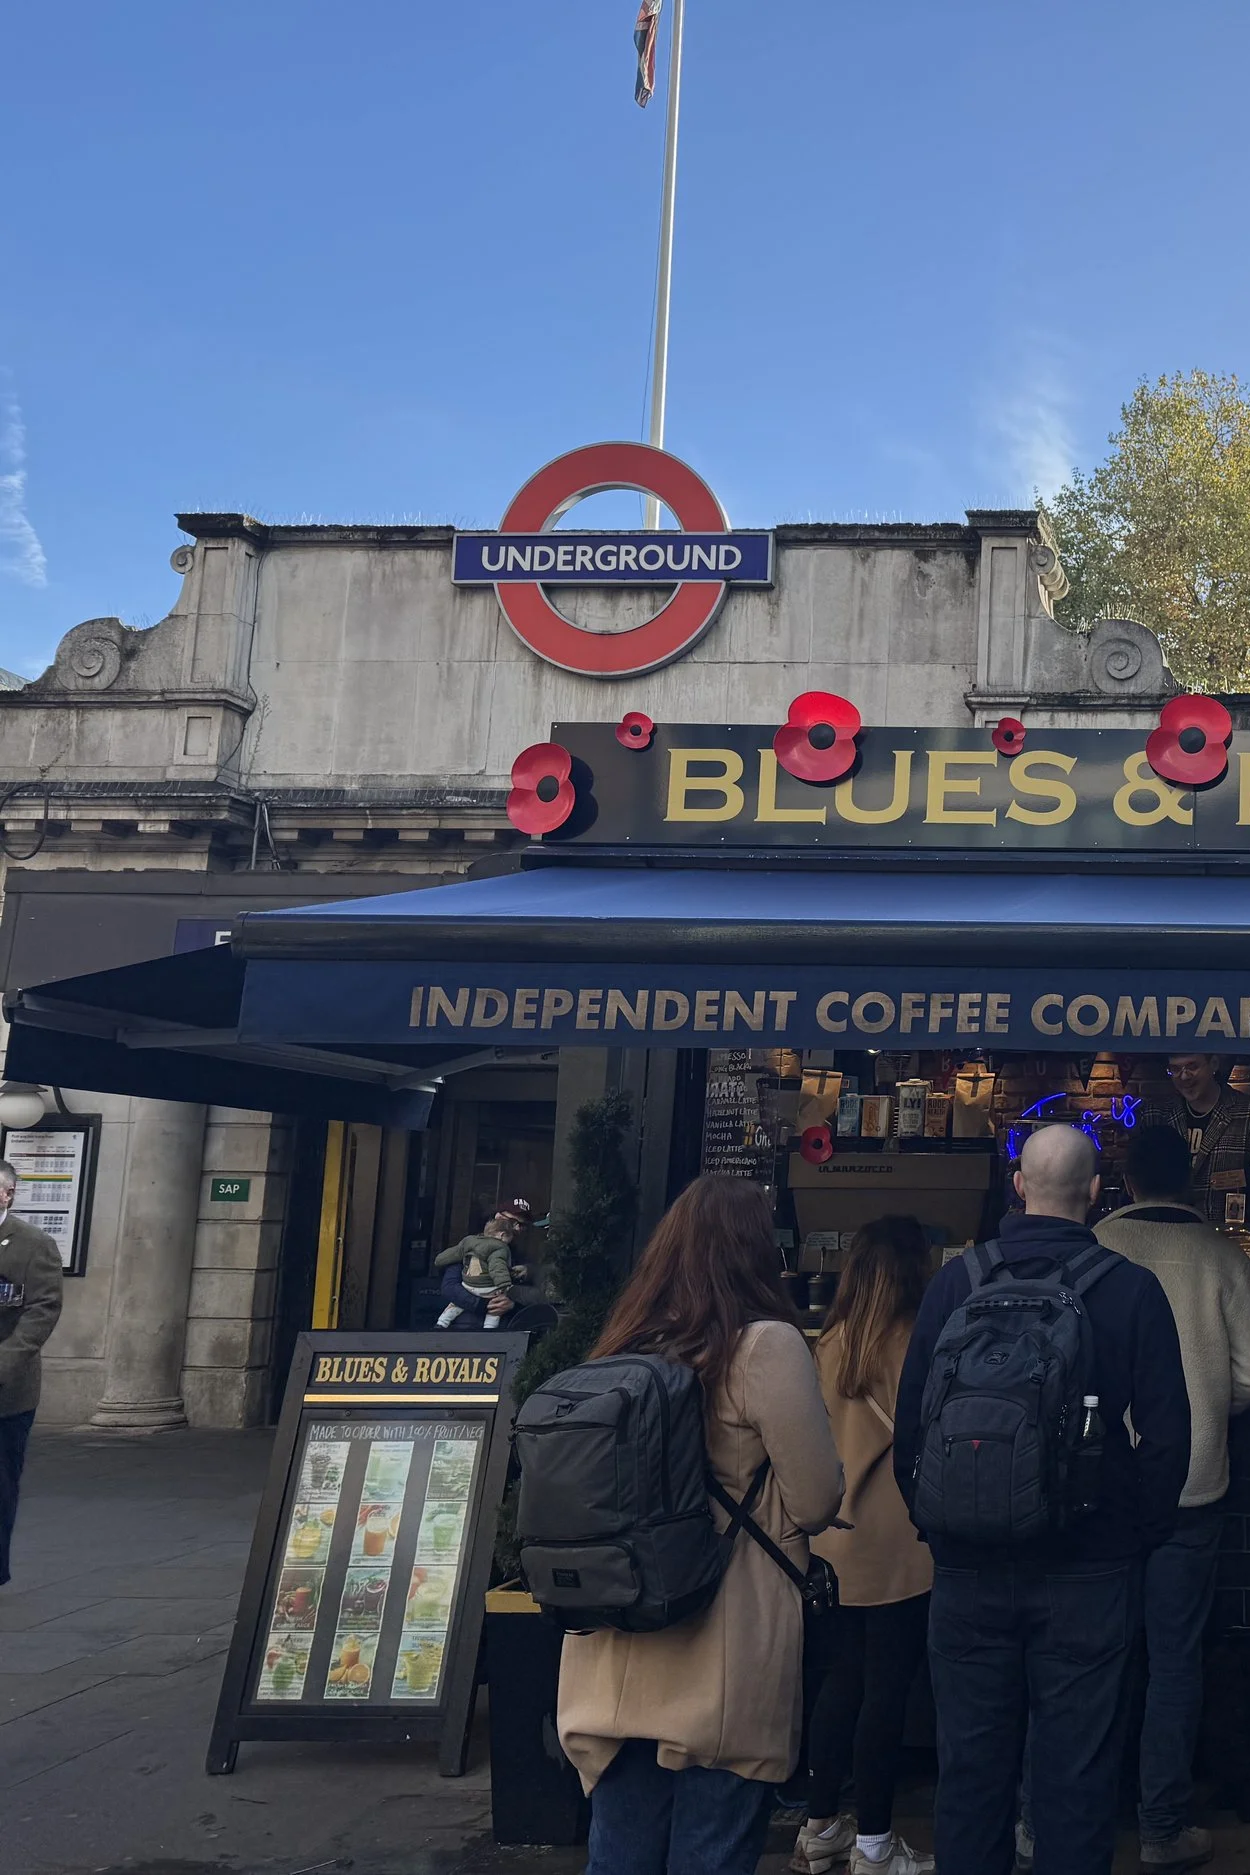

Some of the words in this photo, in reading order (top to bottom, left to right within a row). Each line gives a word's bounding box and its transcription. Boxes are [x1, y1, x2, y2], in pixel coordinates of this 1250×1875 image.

[481, 544, 742, 571] UNDERGROUND
[663, 748, 1077, 828] BLUES
[1113, 751, 1194, 826] &
[409, 986, 798, 1031] INDEPENDENT
[815, 990, 1011, 1033] COFFEE
[218, 1184, 240, 1194] SAP
[316, 1357, 387, 1383] BLUES
[391, 1357, 410, 1383] &
[413, 1357, 499, 1383] ROYALS
[309, 1424, 337, 1440] MADE
[341, 1425, 351, 1437] TO
[352, 1425, 381, 1440] ORDER
